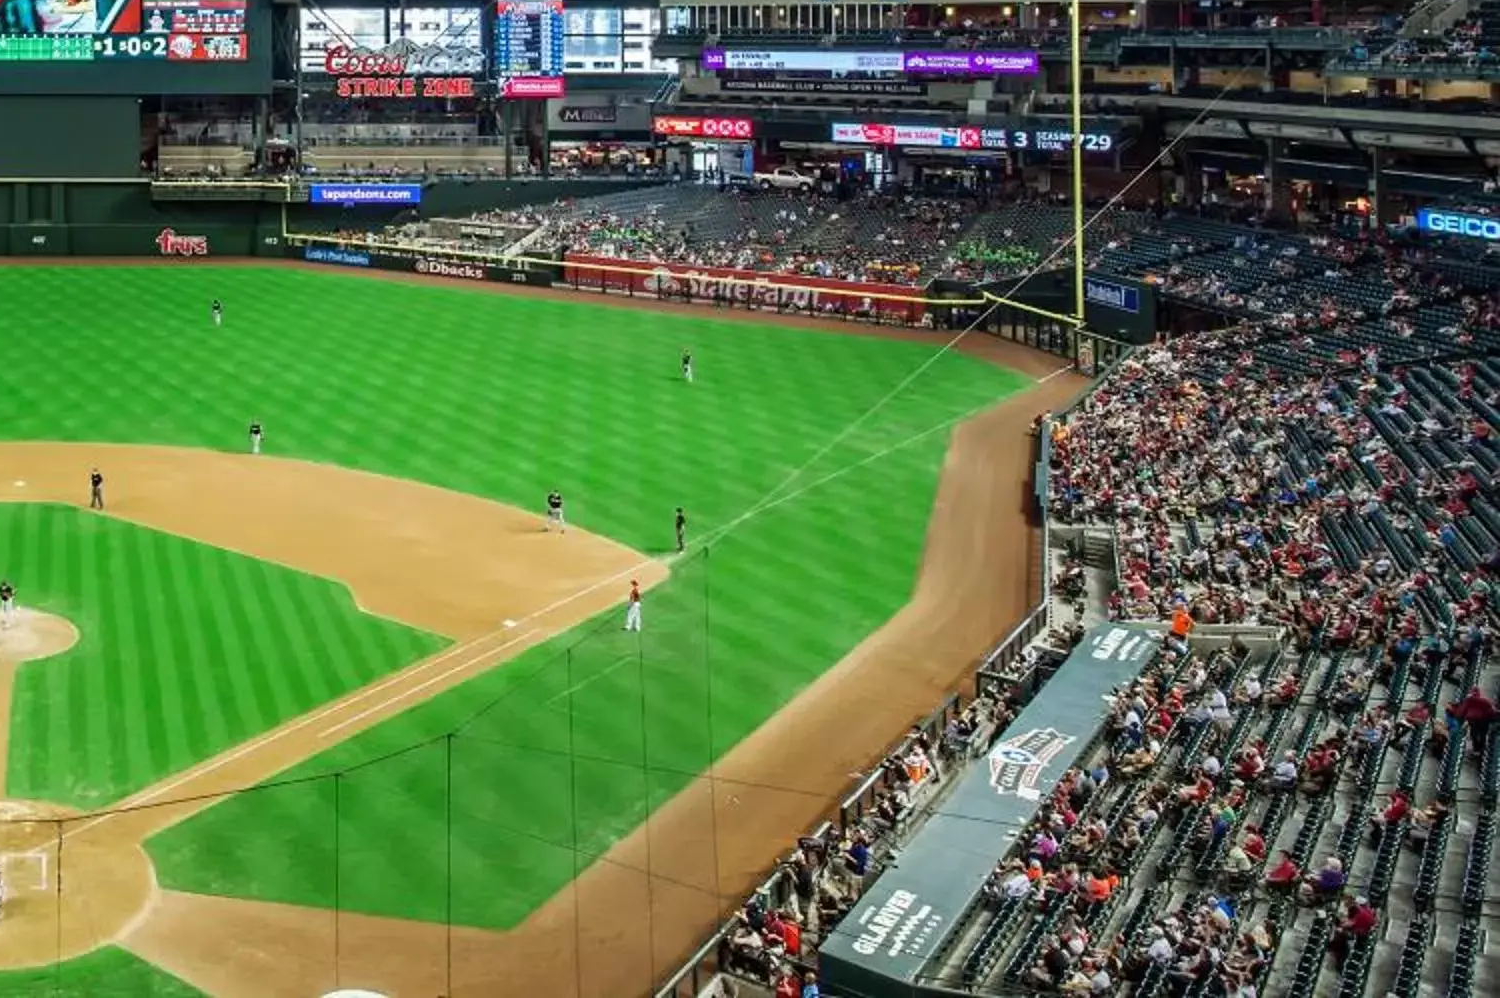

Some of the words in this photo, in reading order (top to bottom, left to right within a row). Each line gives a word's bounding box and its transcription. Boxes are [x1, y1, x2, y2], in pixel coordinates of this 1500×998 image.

[104, 38, 116, 55] 1
[127, 38, 141, 55] 0
[153, 38, 166, 55] 2
[337, 78, 417, 97] STRIKE
[423, 78, 475, 97] ZONE
[1014, 131, 1028, 148] 3
[321, 188, 411, 201] tapandsons.com
[1428, 213, 1500, 240] GEICO
[687, 270, 747, 300] State
